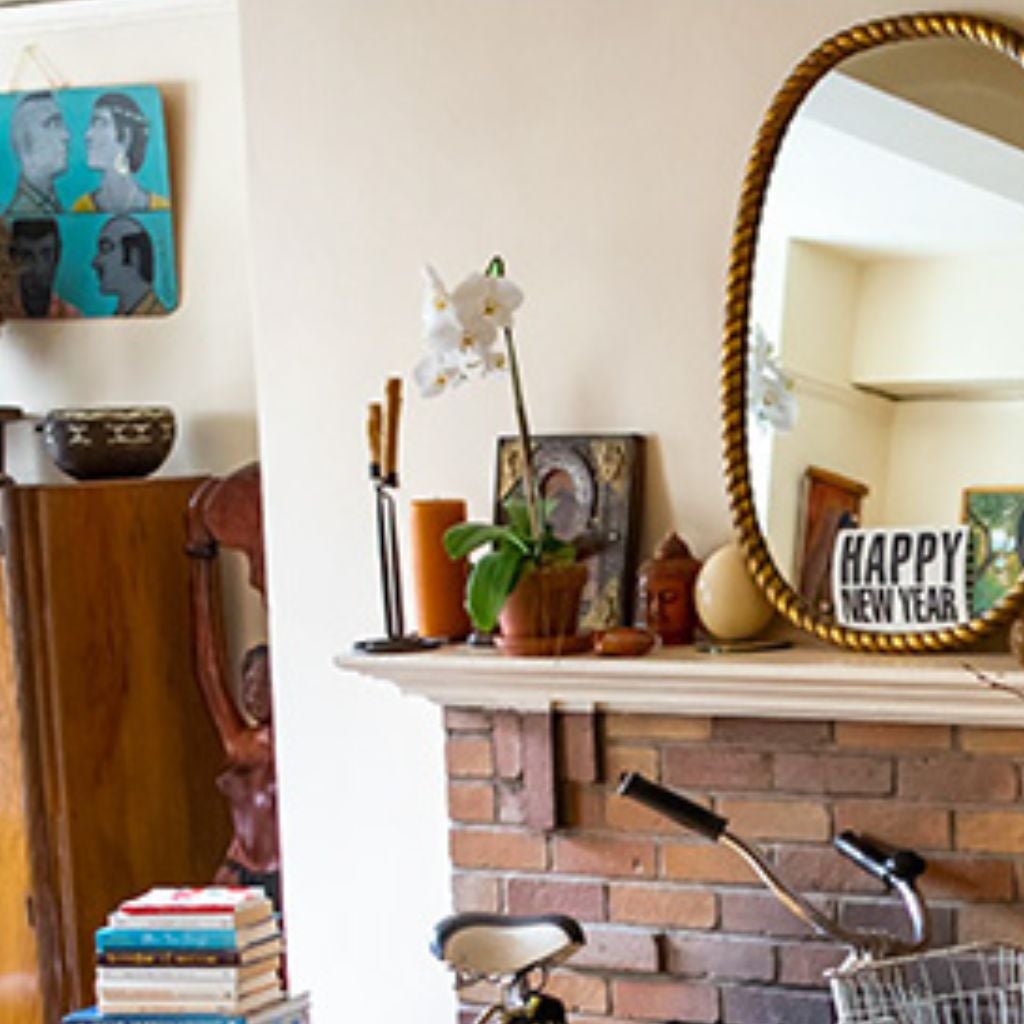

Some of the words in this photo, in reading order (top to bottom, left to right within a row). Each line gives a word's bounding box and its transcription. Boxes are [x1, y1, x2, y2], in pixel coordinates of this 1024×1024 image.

[841, 532, 962, 584] HAPPY
[841, 587, 892, 623] NEW
[898, 586, 958, 623] YEAR
